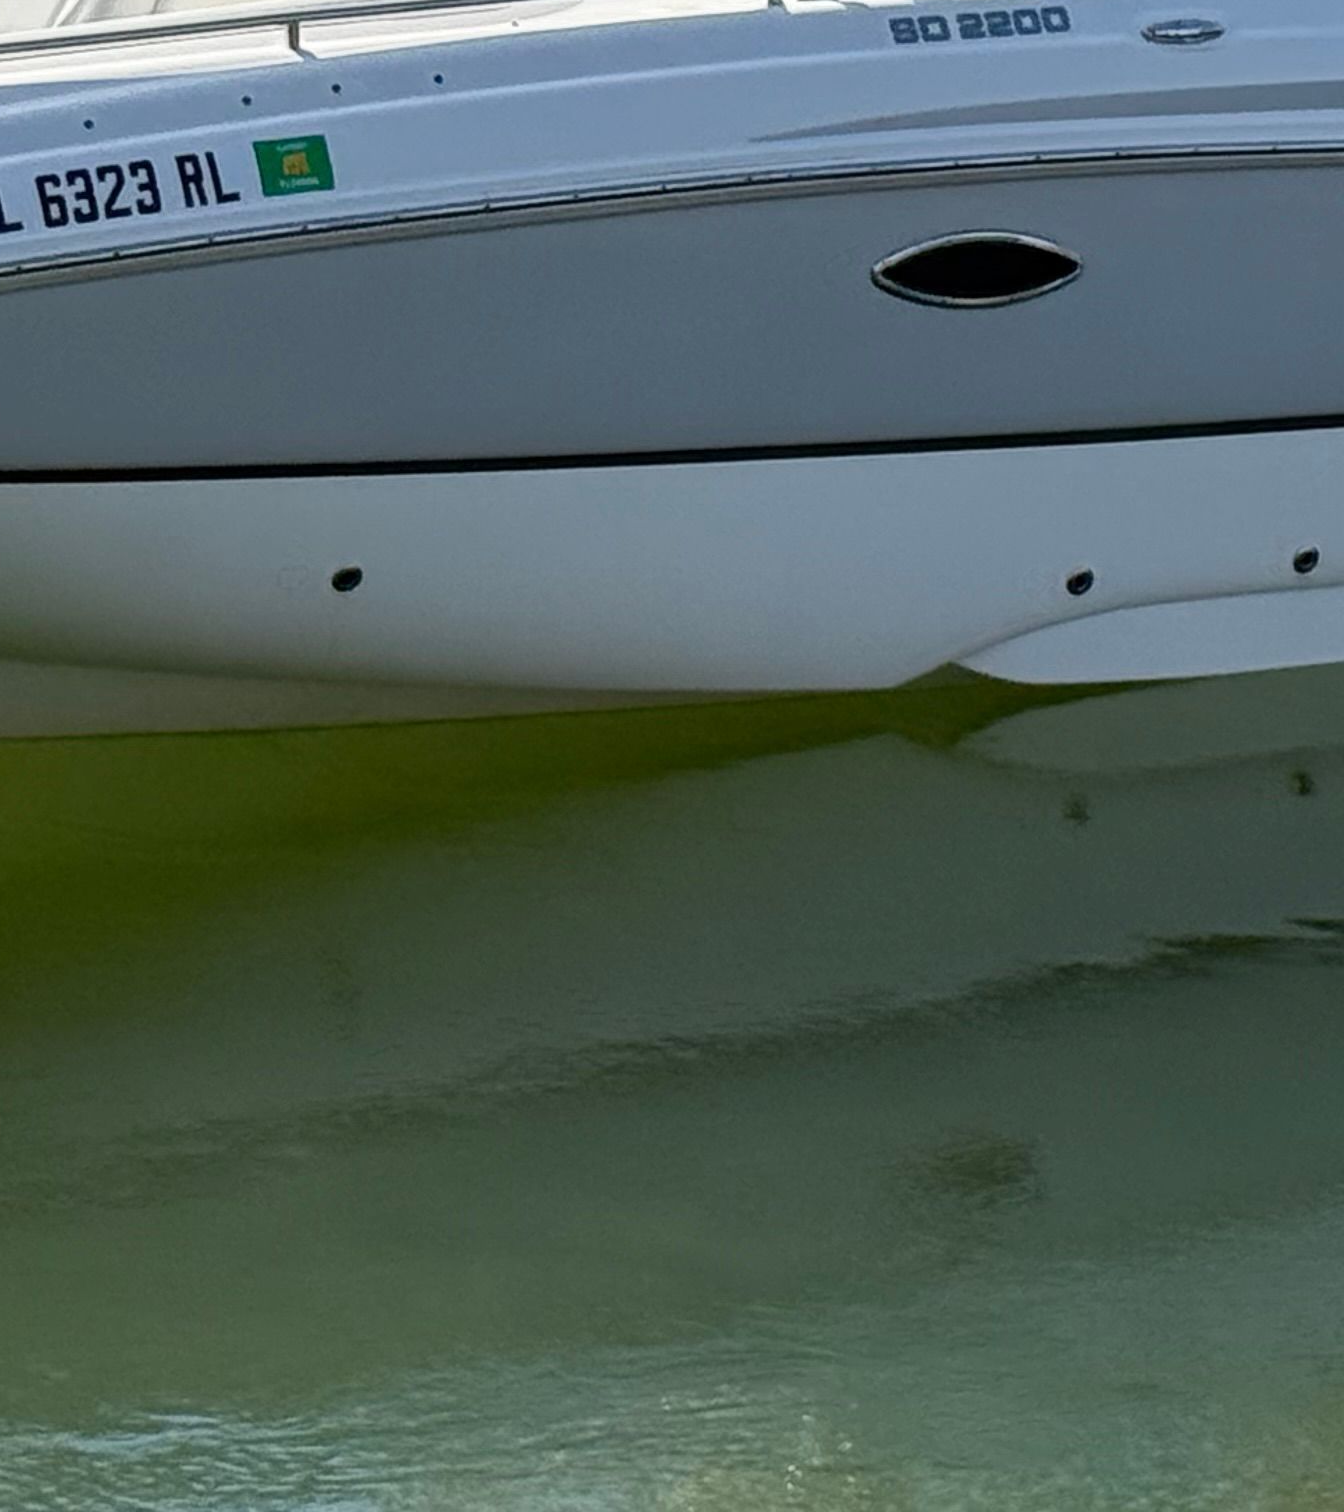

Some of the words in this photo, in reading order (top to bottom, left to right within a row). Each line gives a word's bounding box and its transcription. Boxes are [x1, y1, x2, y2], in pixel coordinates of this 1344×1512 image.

[956, 6, 1071, 40] 2200
[35, 159, 161, 229] 6323
[174, 151, 241, 208] RL
